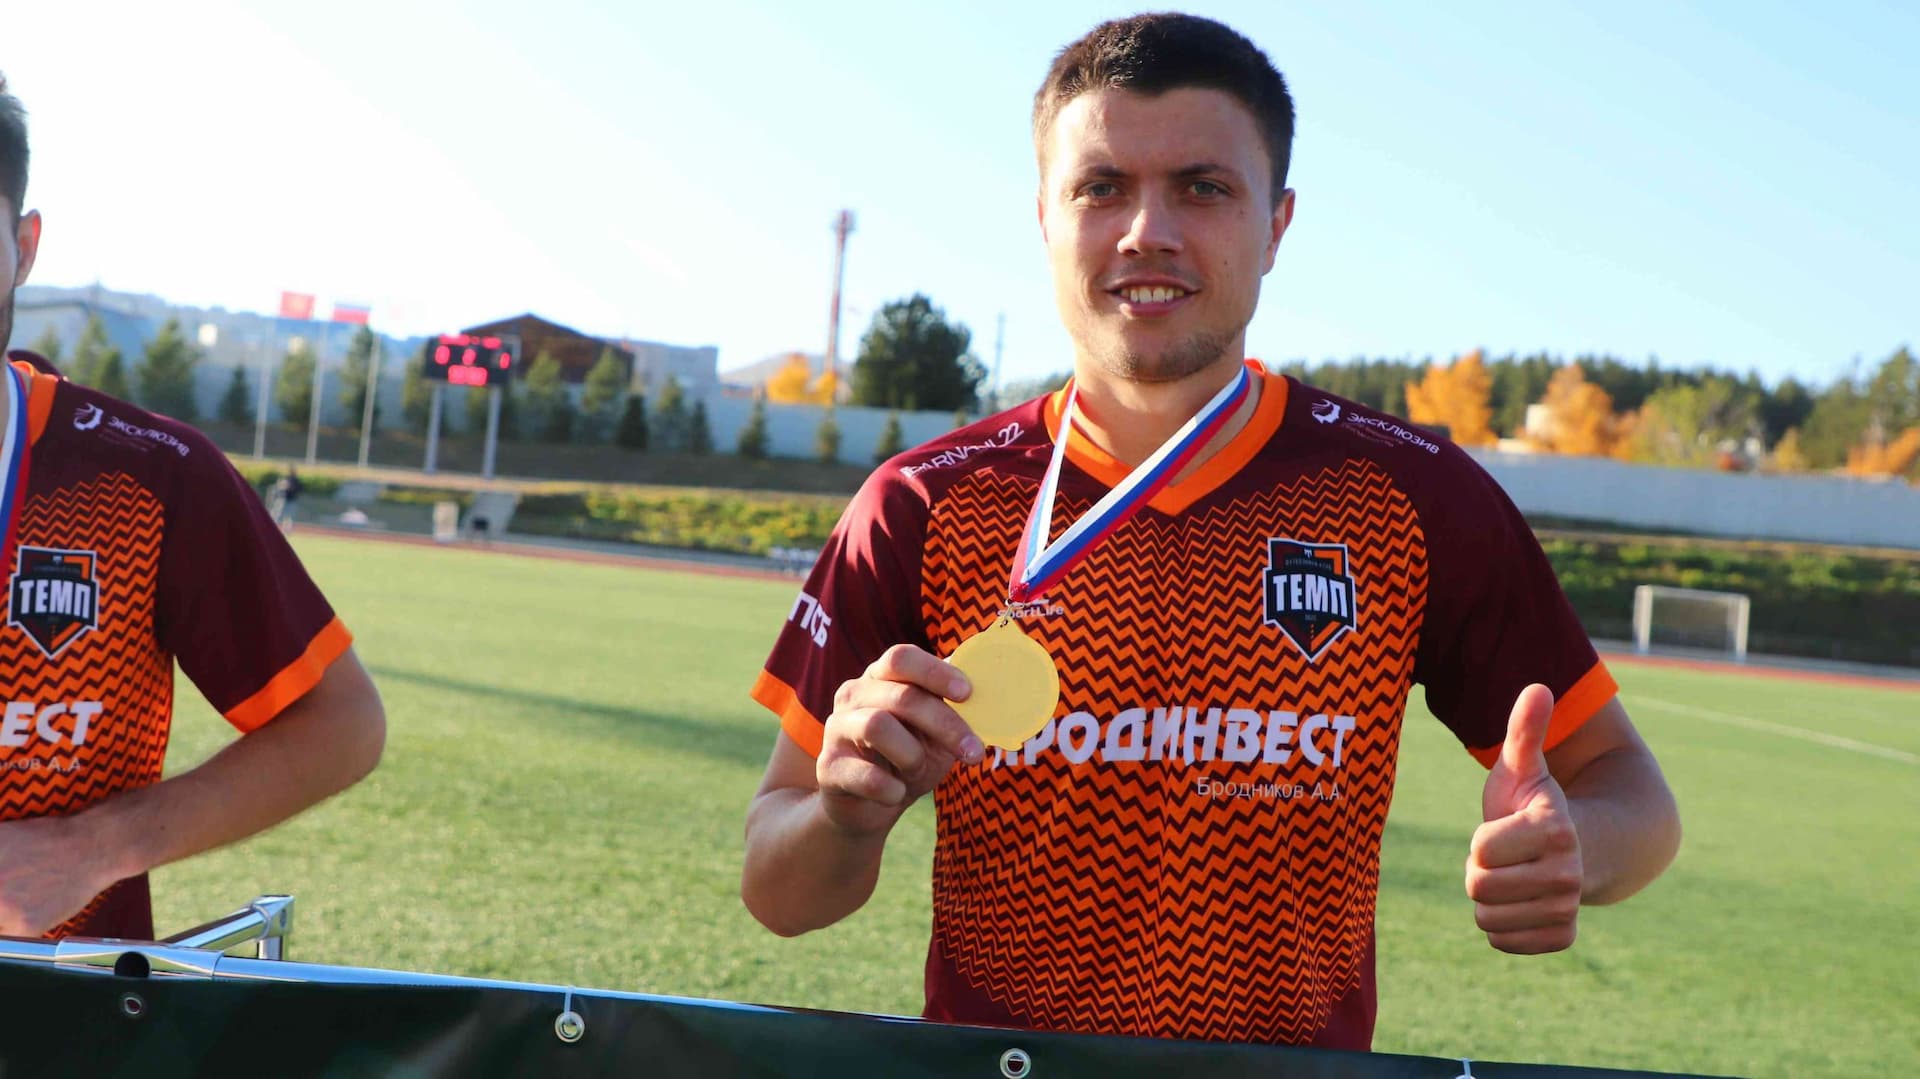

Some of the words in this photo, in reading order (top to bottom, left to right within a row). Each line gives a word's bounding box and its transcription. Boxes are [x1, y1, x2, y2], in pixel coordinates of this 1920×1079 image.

[1346, 411, 1441, 455] ЭКСКЛЮЗИВ
[18, 578, 92, 619] ТЕМП
[1272, 572, 1349, 619] ТЕМП
[1196, 776, 1304, 801] Бродников
